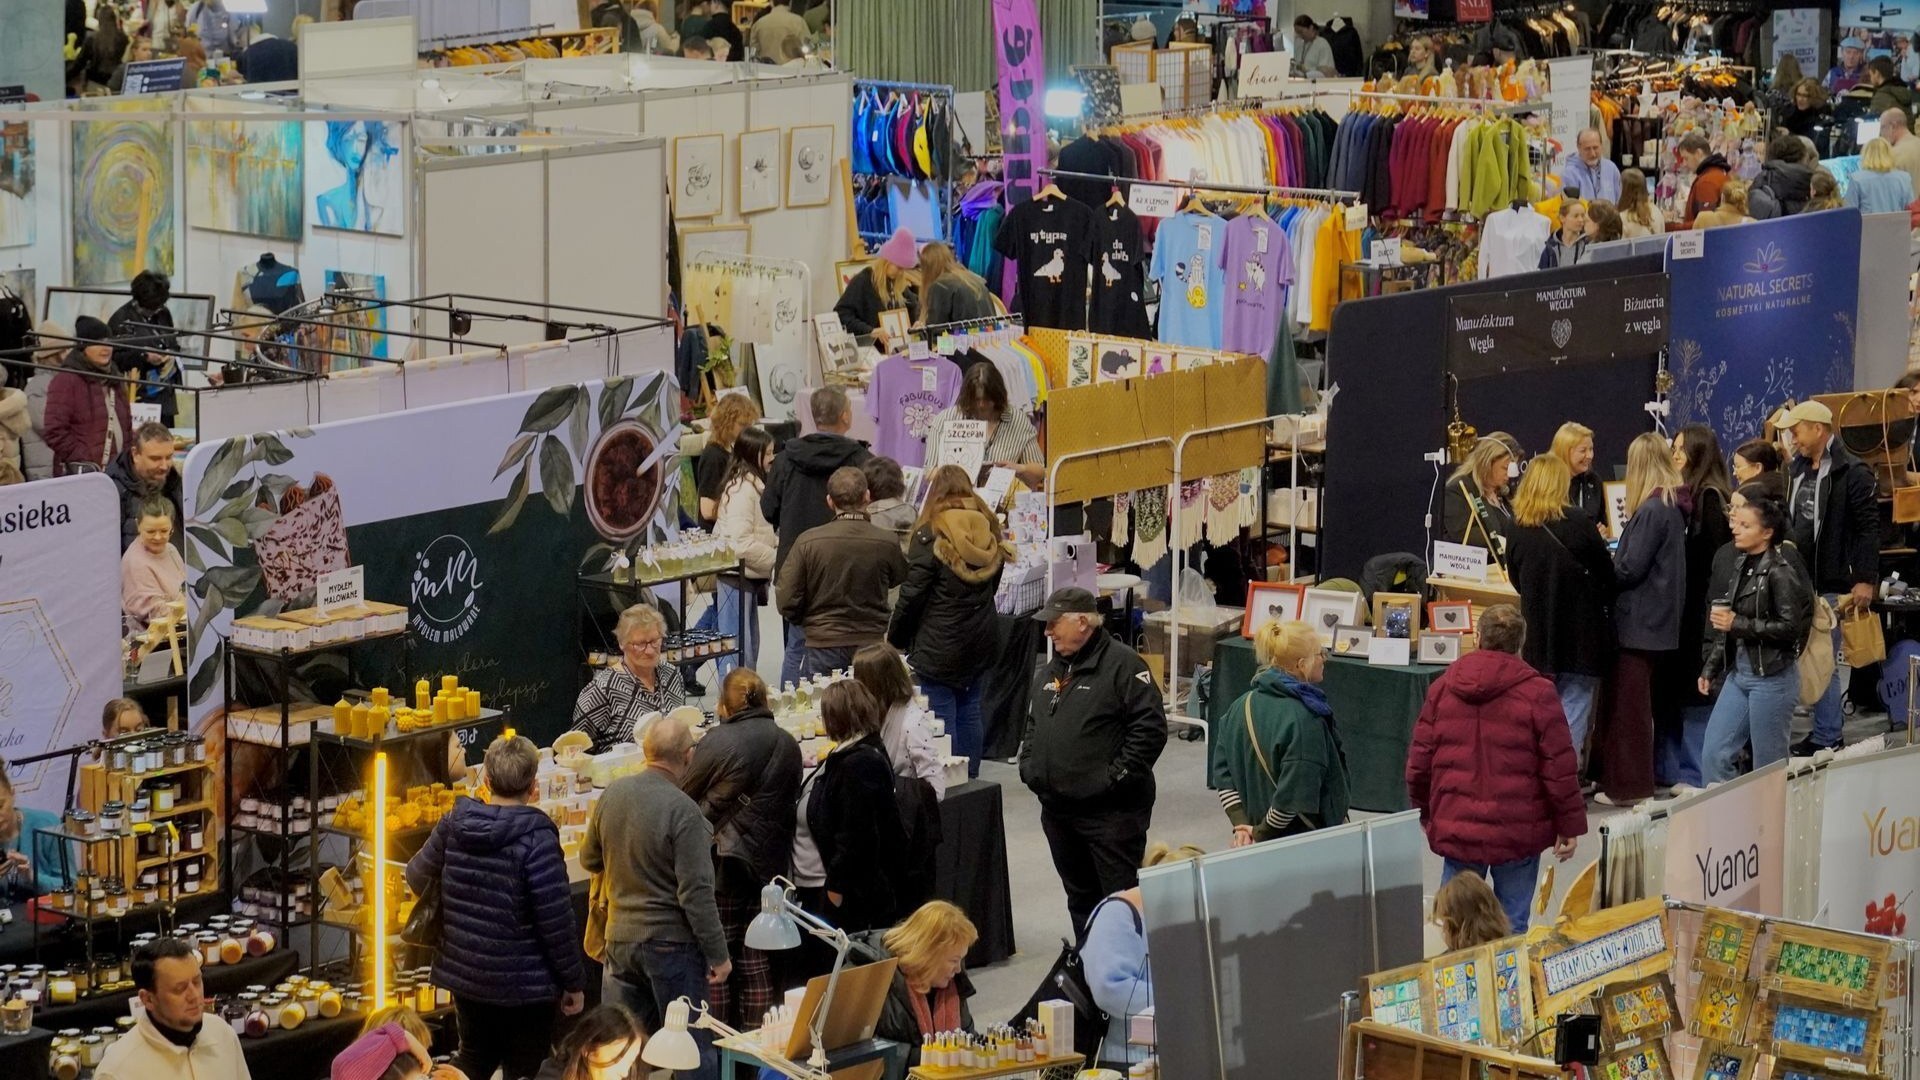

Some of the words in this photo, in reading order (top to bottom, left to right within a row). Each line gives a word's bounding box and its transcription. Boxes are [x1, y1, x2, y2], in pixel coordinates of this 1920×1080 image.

[1717, 281, 1767, 301] NATURAL
[1769, 273, 1814, 294] SECRETS
[1624, 293, 1664, 312] Biżuteria
[1716, 304, 1762, 318] KOSMETYKI
[1765, 295, 1812, 310] NATURALNE
[1455, 313, 1514, 332] Manufaktura
[1625, 323, 1631, 333] z
[1633, 315, 1661, 335] węgla
[1469, 334, 1495, 354] Węgla
[1439, 554, 1481, 564] MANUFAKTURA
[323, 590, 358, 605] MALOWANE
[443, 603, 481, 643] MALOWANE
[1862, 807, 1920, 857] Yua
[1696, 843, 1759, 900] Yuana
